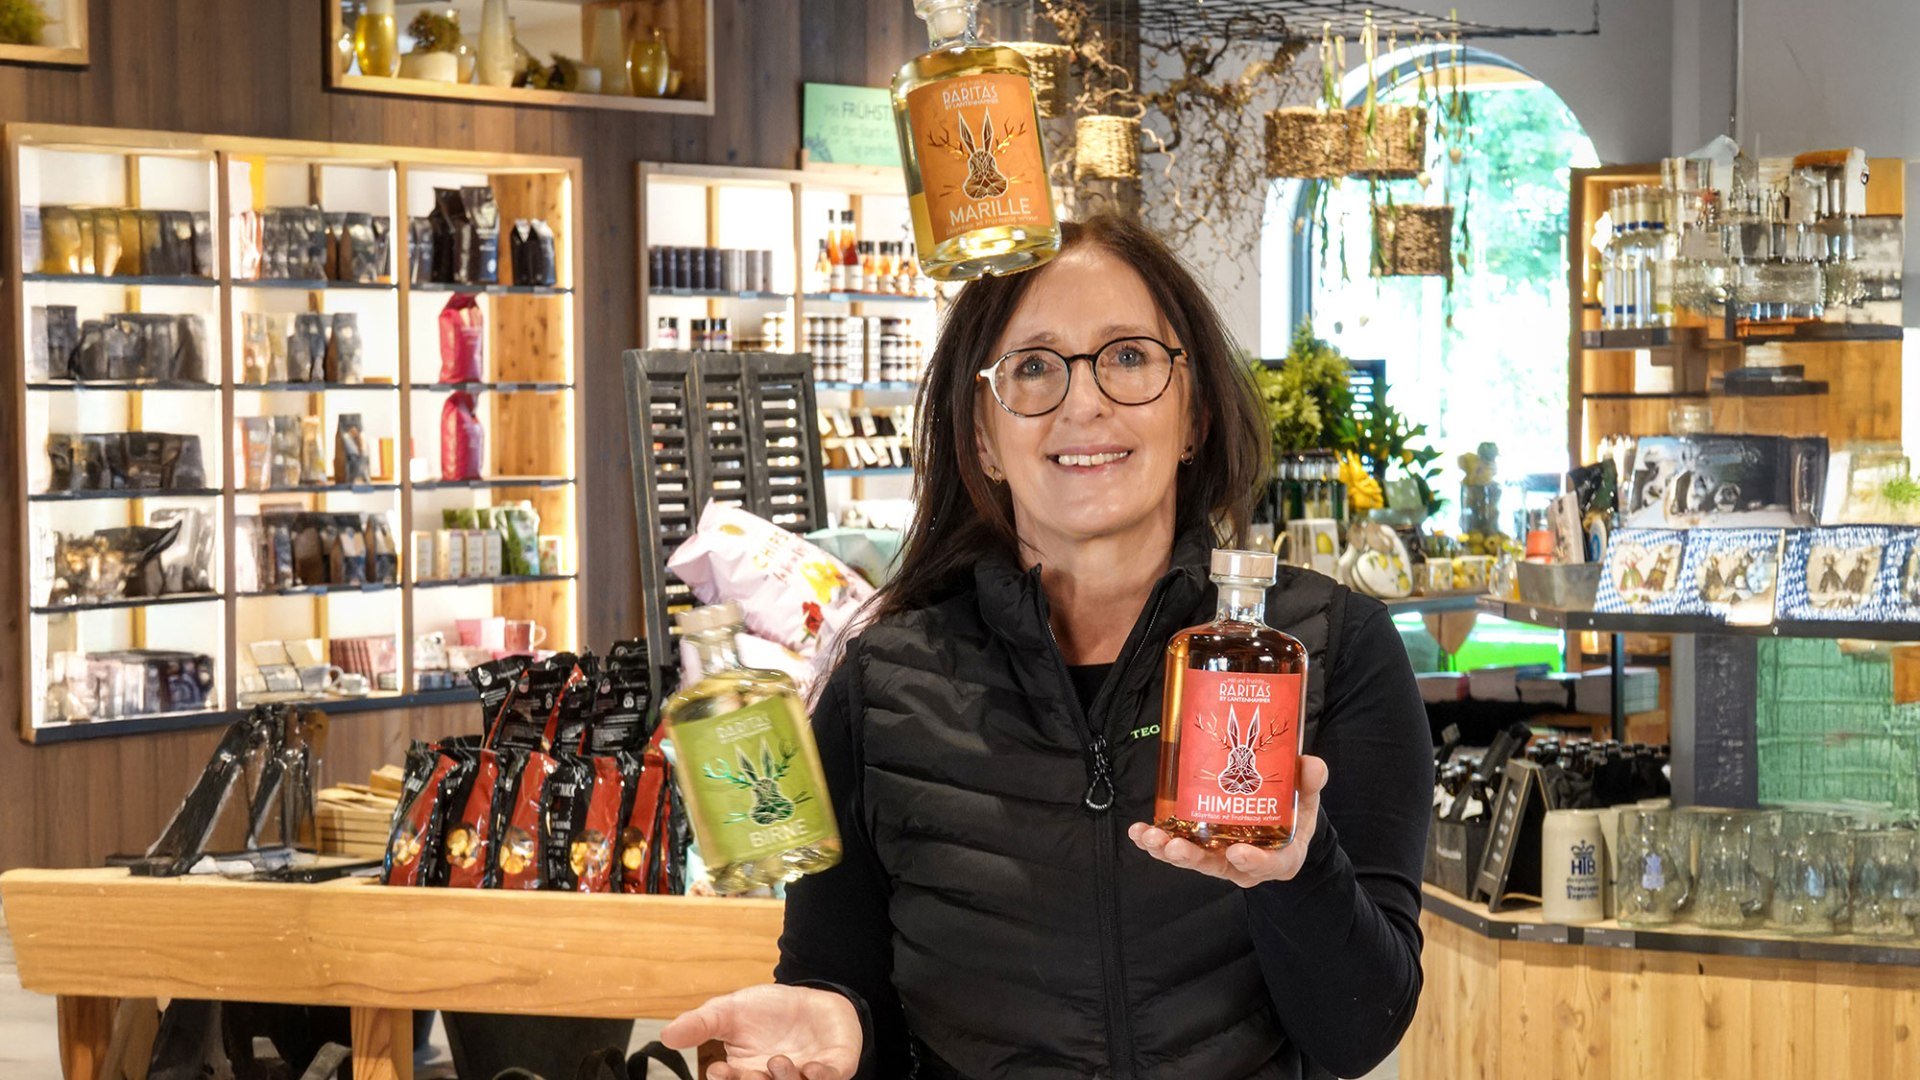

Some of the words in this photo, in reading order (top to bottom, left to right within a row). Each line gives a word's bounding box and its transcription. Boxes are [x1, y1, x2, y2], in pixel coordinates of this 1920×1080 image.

[949, 198, 1031, 227] MARILLE
[1219, 683, 1271, 698] RARITAS
[1197, 794, 1278, 814] HIMBEER
[748, 819, 810, 848] BIRNE
